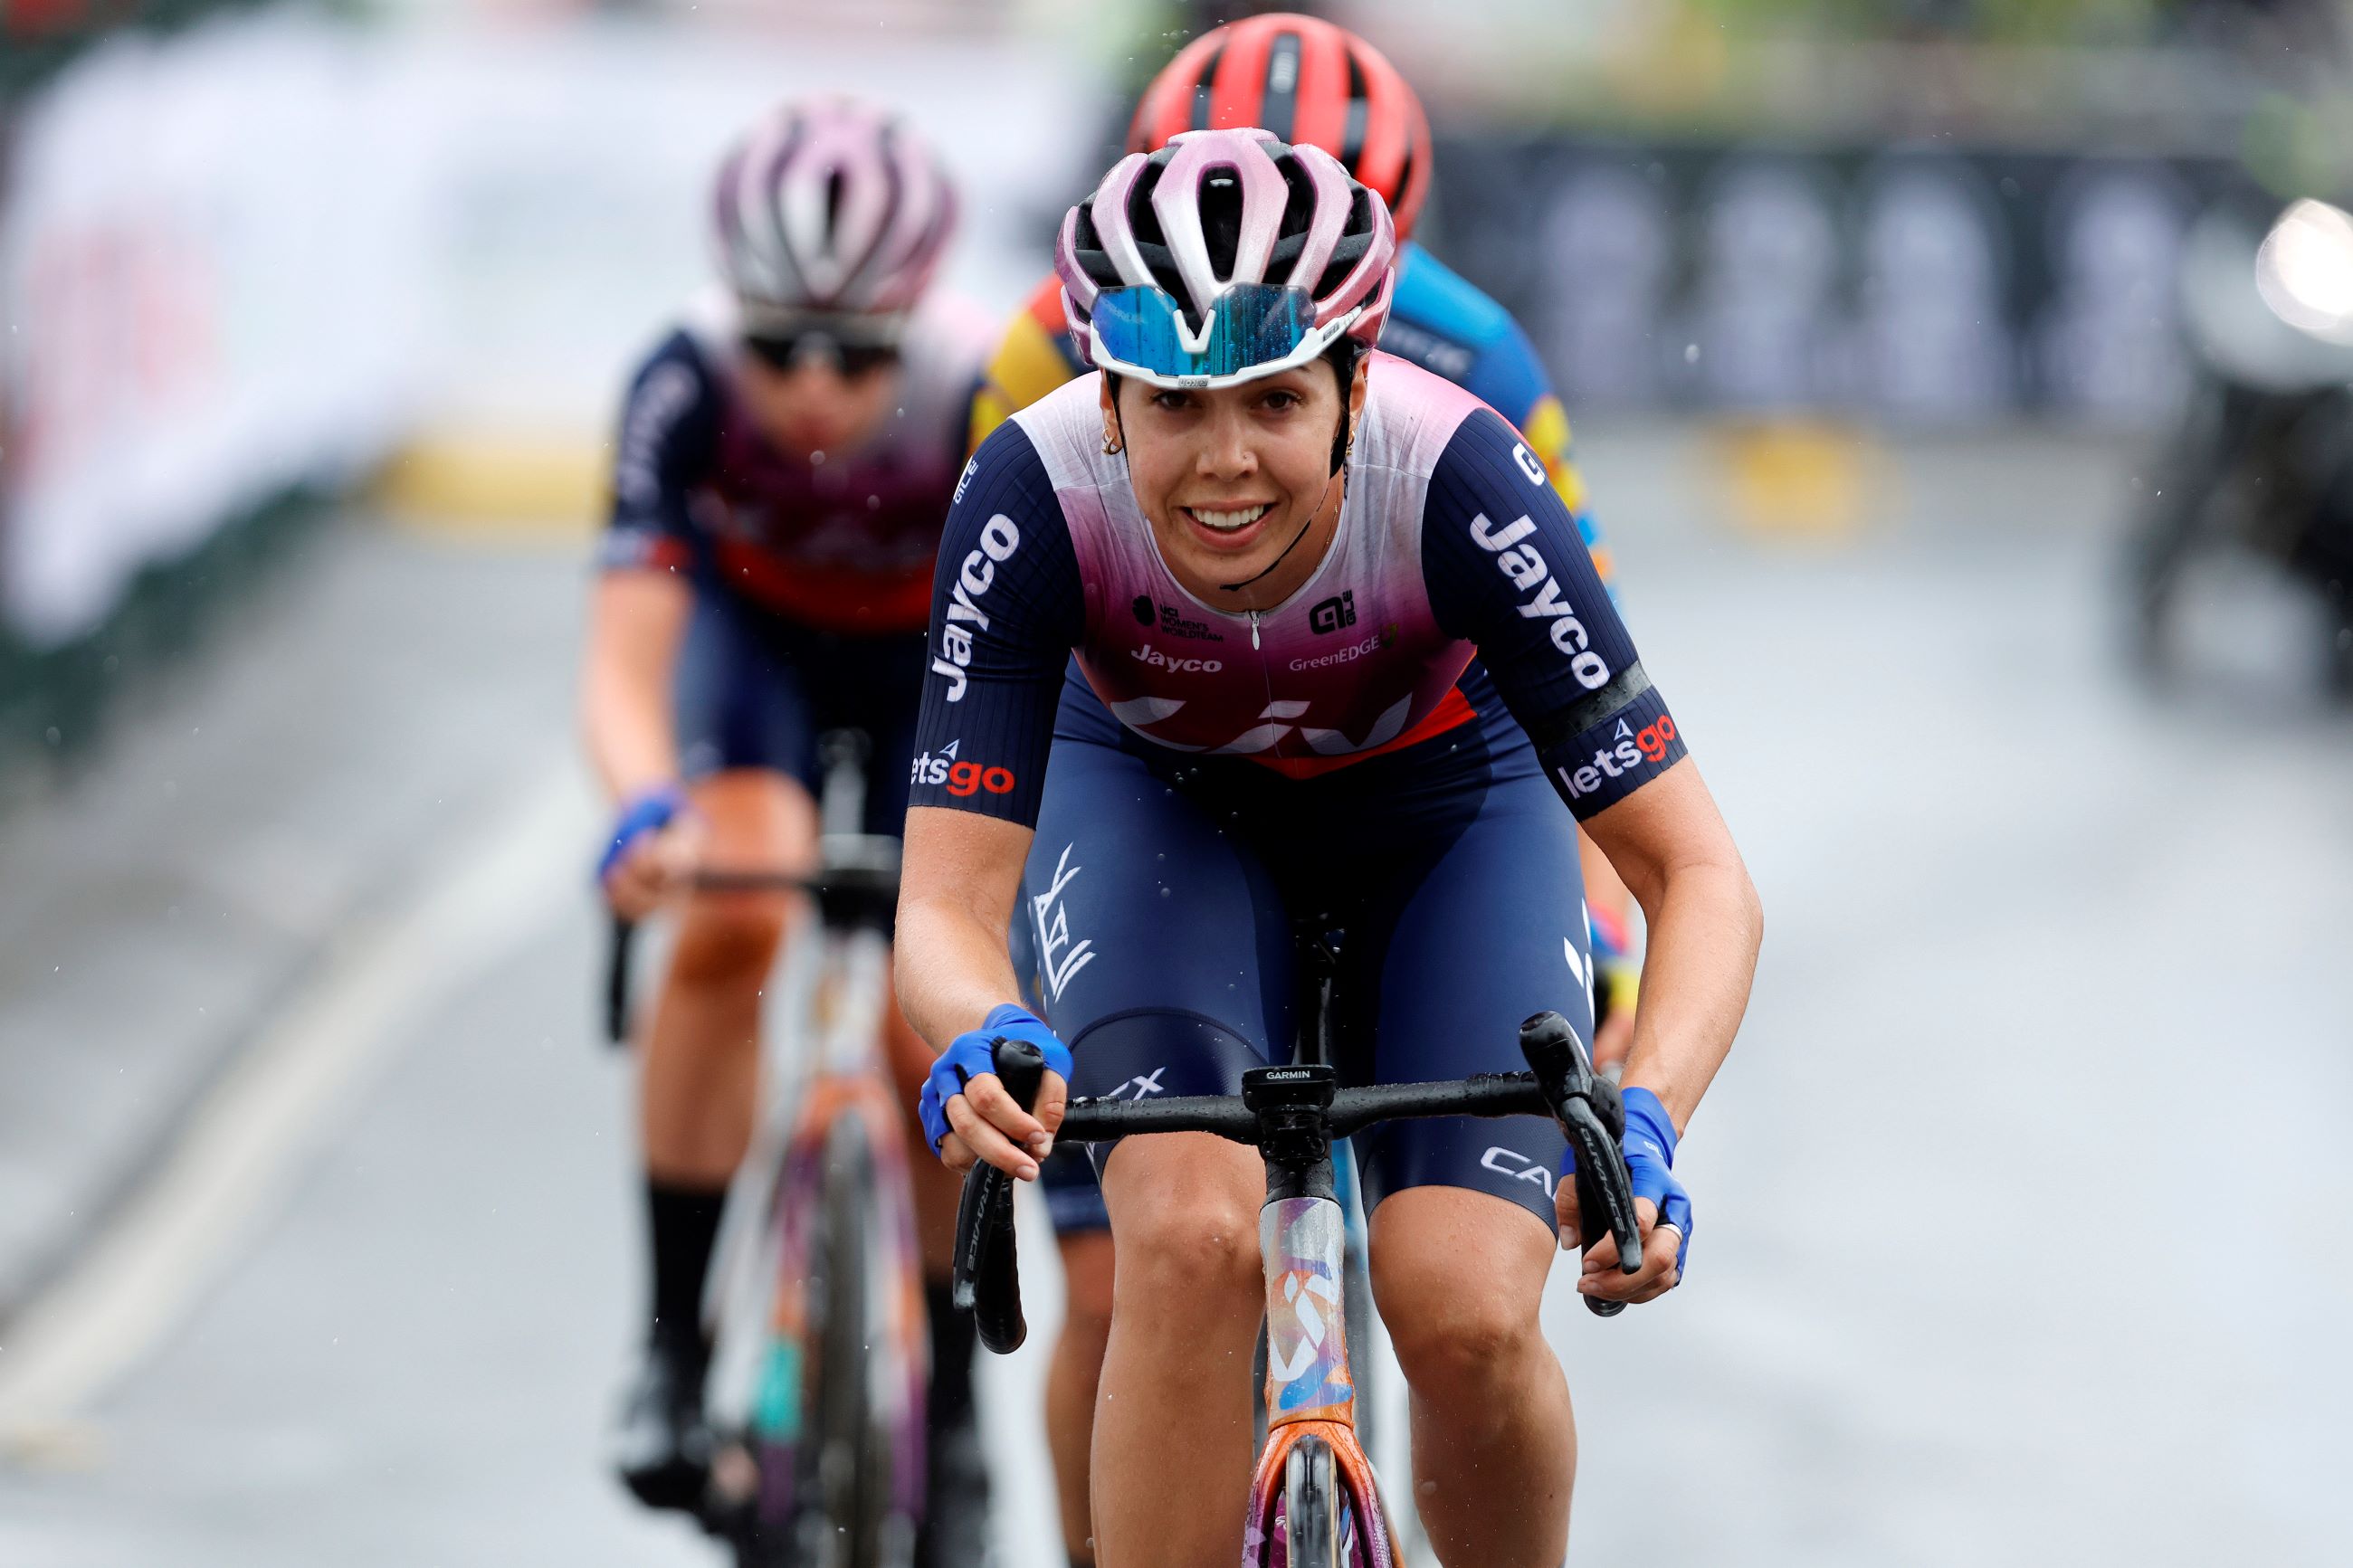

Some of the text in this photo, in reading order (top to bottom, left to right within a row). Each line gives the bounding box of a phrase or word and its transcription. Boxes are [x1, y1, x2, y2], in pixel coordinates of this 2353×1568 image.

[932, 513, 1020, 702] Jayco
[1159, 603, 1179, 618] UCI
[1469, 512, 1611, 690] Jayco
[1160, 614, 1209, 632] WOMEN'S
[1161, 624, 1224, 642] WORLDTEAM
[1130, 643, 1223, 673] Jayco
[1289, 635, 1380, 671] GreenEDGE
[910, 751, 1015, 796] etsgo
[1266, 1070, 1310, 1079] GARMIN
[1579, 1127, 1626, 1231] DURA-ACE
